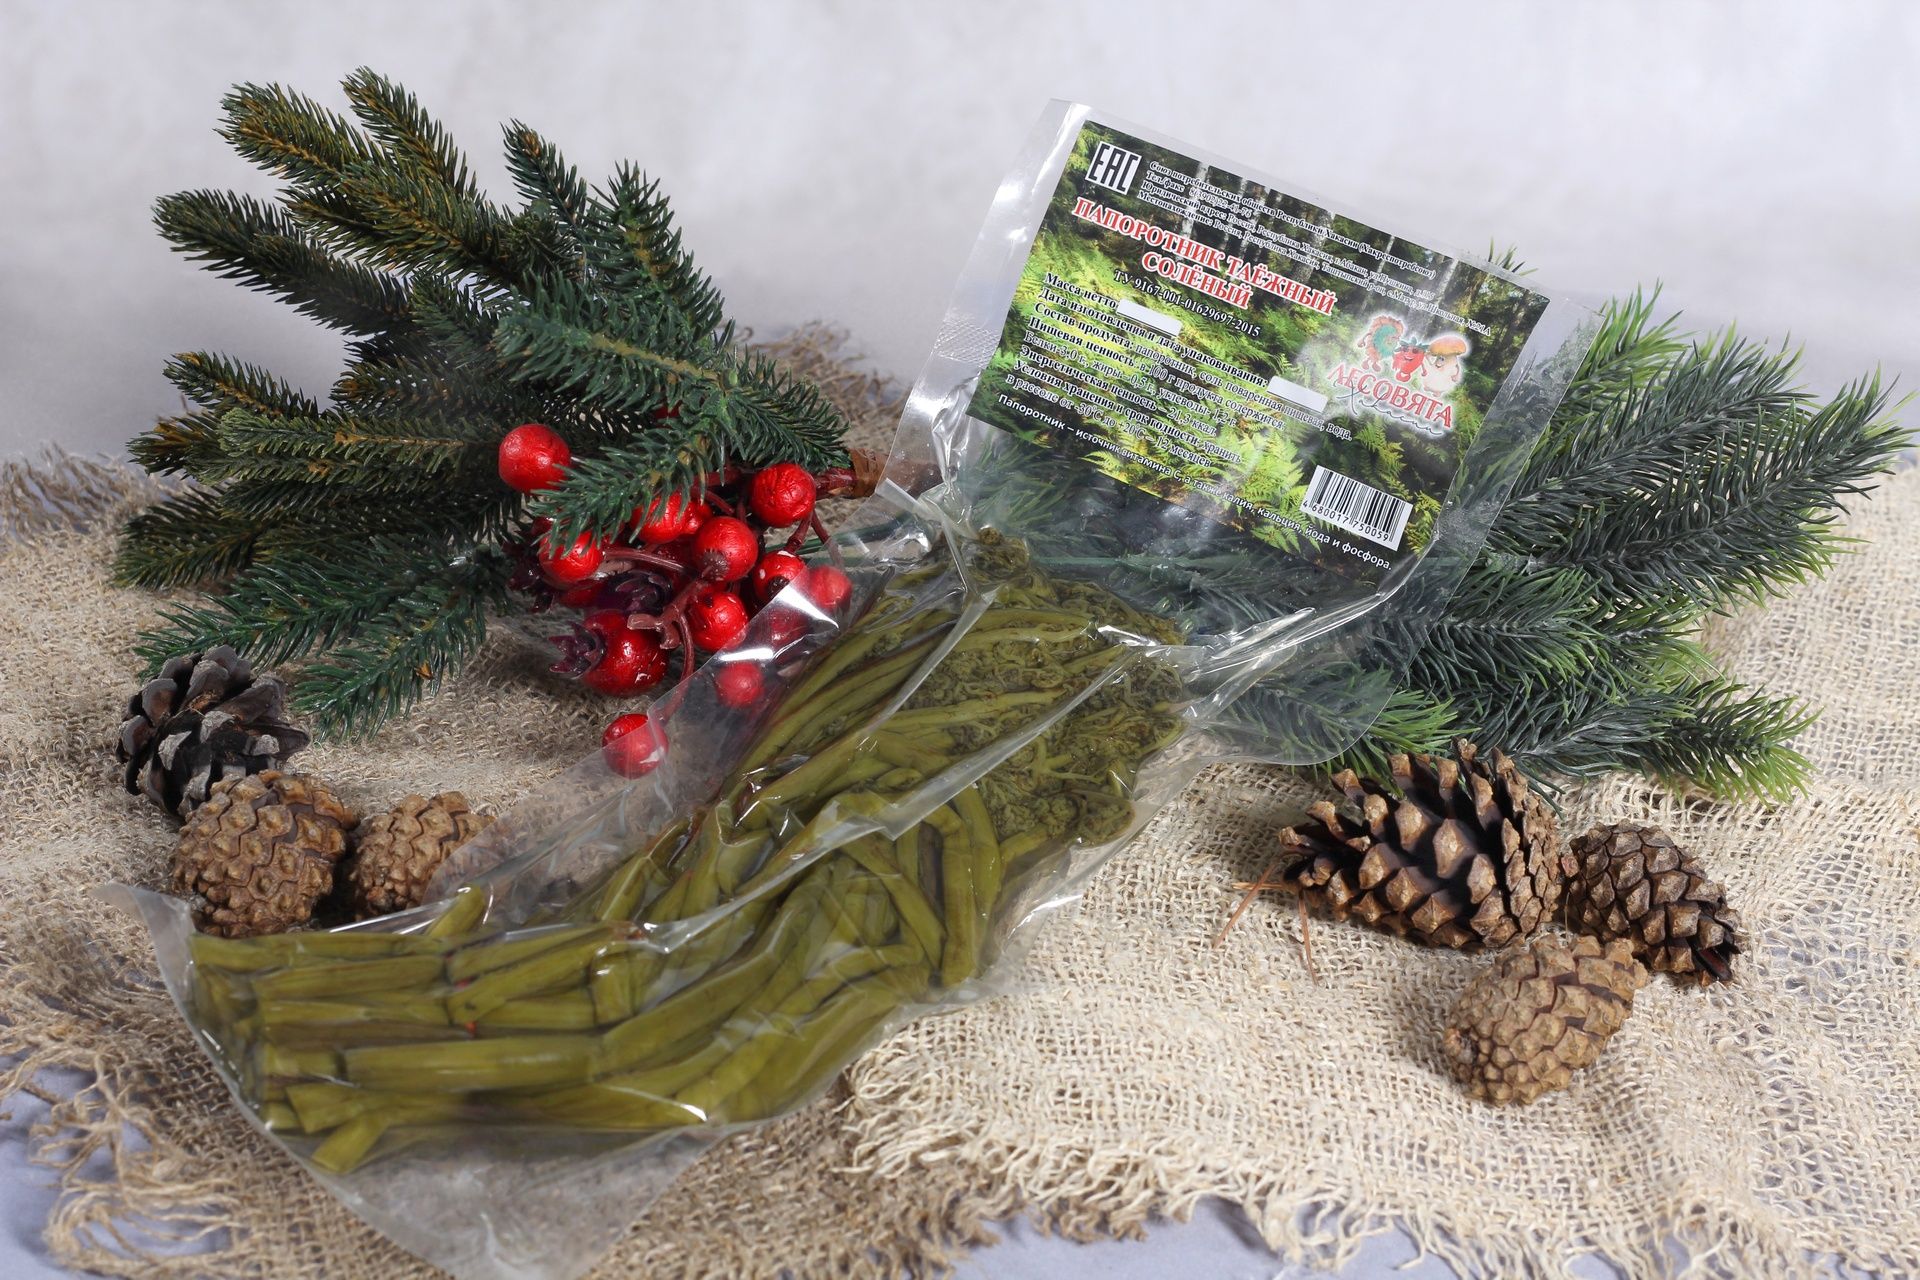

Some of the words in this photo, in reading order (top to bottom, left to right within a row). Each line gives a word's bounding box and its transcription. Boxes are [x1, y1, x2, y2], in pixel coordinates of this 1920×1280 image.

[1141, 179, 1201, 210] Юридический
[1200, 204, 1227, 220] адрес:
[1227, 212, 1257, 234] Россия,
[1257, 223, 1301, 249] Республика
[1301, 240, 1334, 264] Хакасия,
[1145, 169, 1185, 192] Тел./факс
[1149, 159, 1172, 176] Союз
[1172, 170, 1242, 203] потребительских
[1242, 197, 1276, 217] обществ
[1276, 209, 1324, 235] Республики
[1324, 227, 1361, 249] Хакасии
[1358, 241, 1437, 281] (Хакреспотребсоюз)
[1072, 196, 1226, 270] ПАПОРОТНИК
[1225, 255, 1337, 315] ТАЁЖНЫЙ
[1137, 188, 1214, 226] Местонахождение:
[1214, 218, 1243, 240] Россия,
[1243, 229, 1287, 255] Республика
[1287, 247, 1321, 270] Хакасия,
[1322, 260, 1370, 287] Таштыпский
[1141, 252, 1253, 309] СОЛЁНЫЙ
[1045, 272, 1081, 295] Масса
[1113, 269, 1133, 285] ТУ
[1134, 278, 1261, 336] 9167-001-01629697-2015
[1030, 315, 1083, 346] Пищевая
[1140, 362, 1146, 372] в
[1149, 364, 1169, 381] 100
[1167, 374, 1176, 384] г
[1175, 377, 1224, 404] продукта
[1035, 300, 1076, 326] Состав
[1078, 320, 1134, 350] продукта:
[1136, 343, 1199, 378] папоротник,
[1200, 370, 1224, 386] соль
[1226, 380, 1282, 411] поваренная
[1284, 405, 1326, 432] пищевая,
[1326, 423, 1353, 441] вода.
[1040, 286, 1068, 306] Дата
[1070, 300, 1146, 337] изготовления
[1147, 331, 1156, 341] и
[1156, 335, 1181, 351] дата
[1182, 345, 1267, 388] упаковывания:
[1092, 360, 1122, 378] жиры
[1006, 374, 1015, 384] в
[1013, 377, 1059, 403] рассоле
[1059, 396, 1074, 409] от
[1102, 415, 1117, 427] до
[1156, 435, 1170, 450] 12
[1169, 443, 1212, 468] месяцев
[1014, 358, 1062, 387] Условия
[1063, 381, 1115, 409] хранения
[1116, 403, 1127, 414] и
[1125, 407, 1150, 424] срок
[1203, 439, 1242, 463] хранить
[1020, 344, 1110, 390] Энергетическая
[1110, 384, 1158, 410] ценность
[1167, 405, 1192, 425] 21,3
[1192, 418, 1217, 436] ккал.
[1327, 363, 1451, 427] ЛЕСОВЯТА
[998, 393, 1066, 430] Папоротник
[1076, 428, 1121, 453] источник
[1122, 448, 1172, 475] витамина
[1185, 475, 1191, 484] а
[1193, 478, 1222, 497] также
[1223, 491, 1256, 513] калия,
[1258, 506, 1303, 533] кальция,
[1305, 525, 1330, 543] йода
[1332, 538, 1341, 548] и
[1341, 541, 1393, 571] фосфора.
[1312, 504, 1349, 524] 680017
[1352, 520, 1390, 542] 750059
